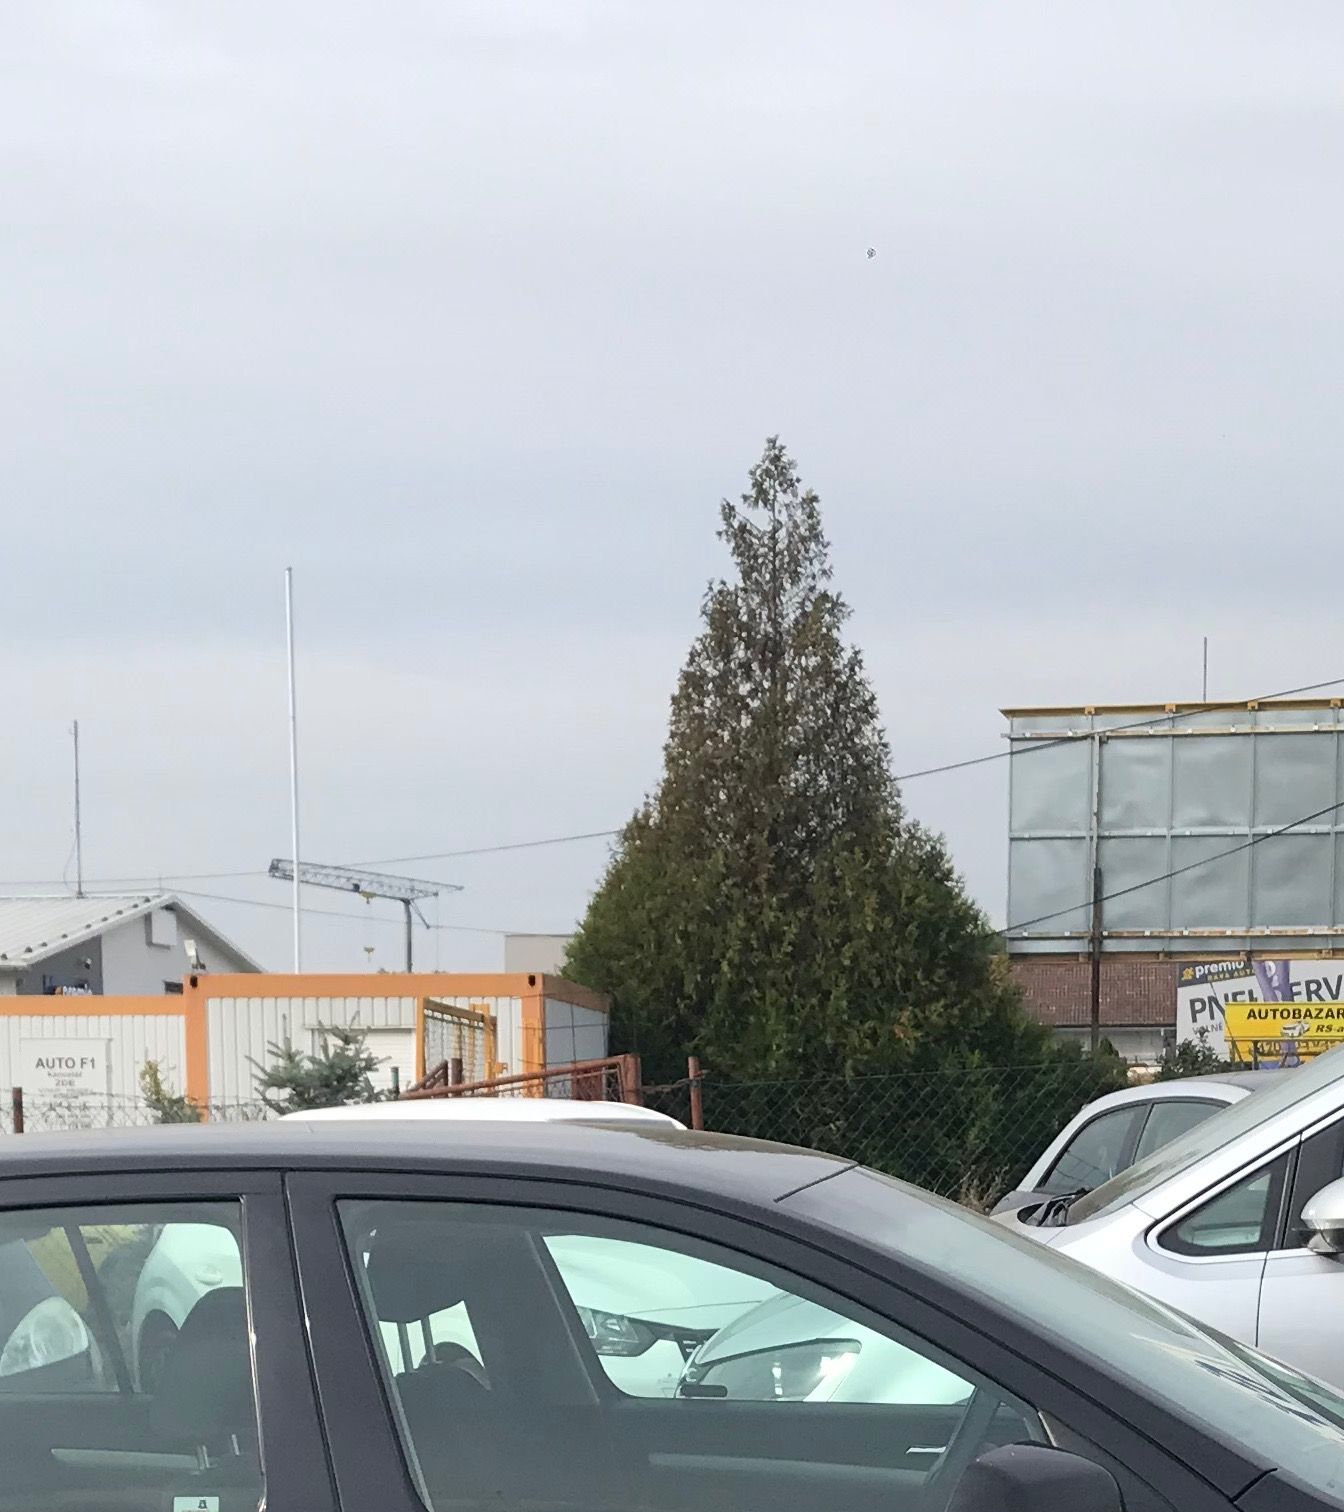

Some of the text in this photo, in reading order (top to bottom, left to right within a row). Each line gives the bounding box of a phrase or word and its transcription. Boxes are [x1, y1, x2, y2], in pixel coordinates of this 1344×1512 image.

[1195, 960, 1245, 978] premio
[35, 1057, 95, 1069] AUTO F1
